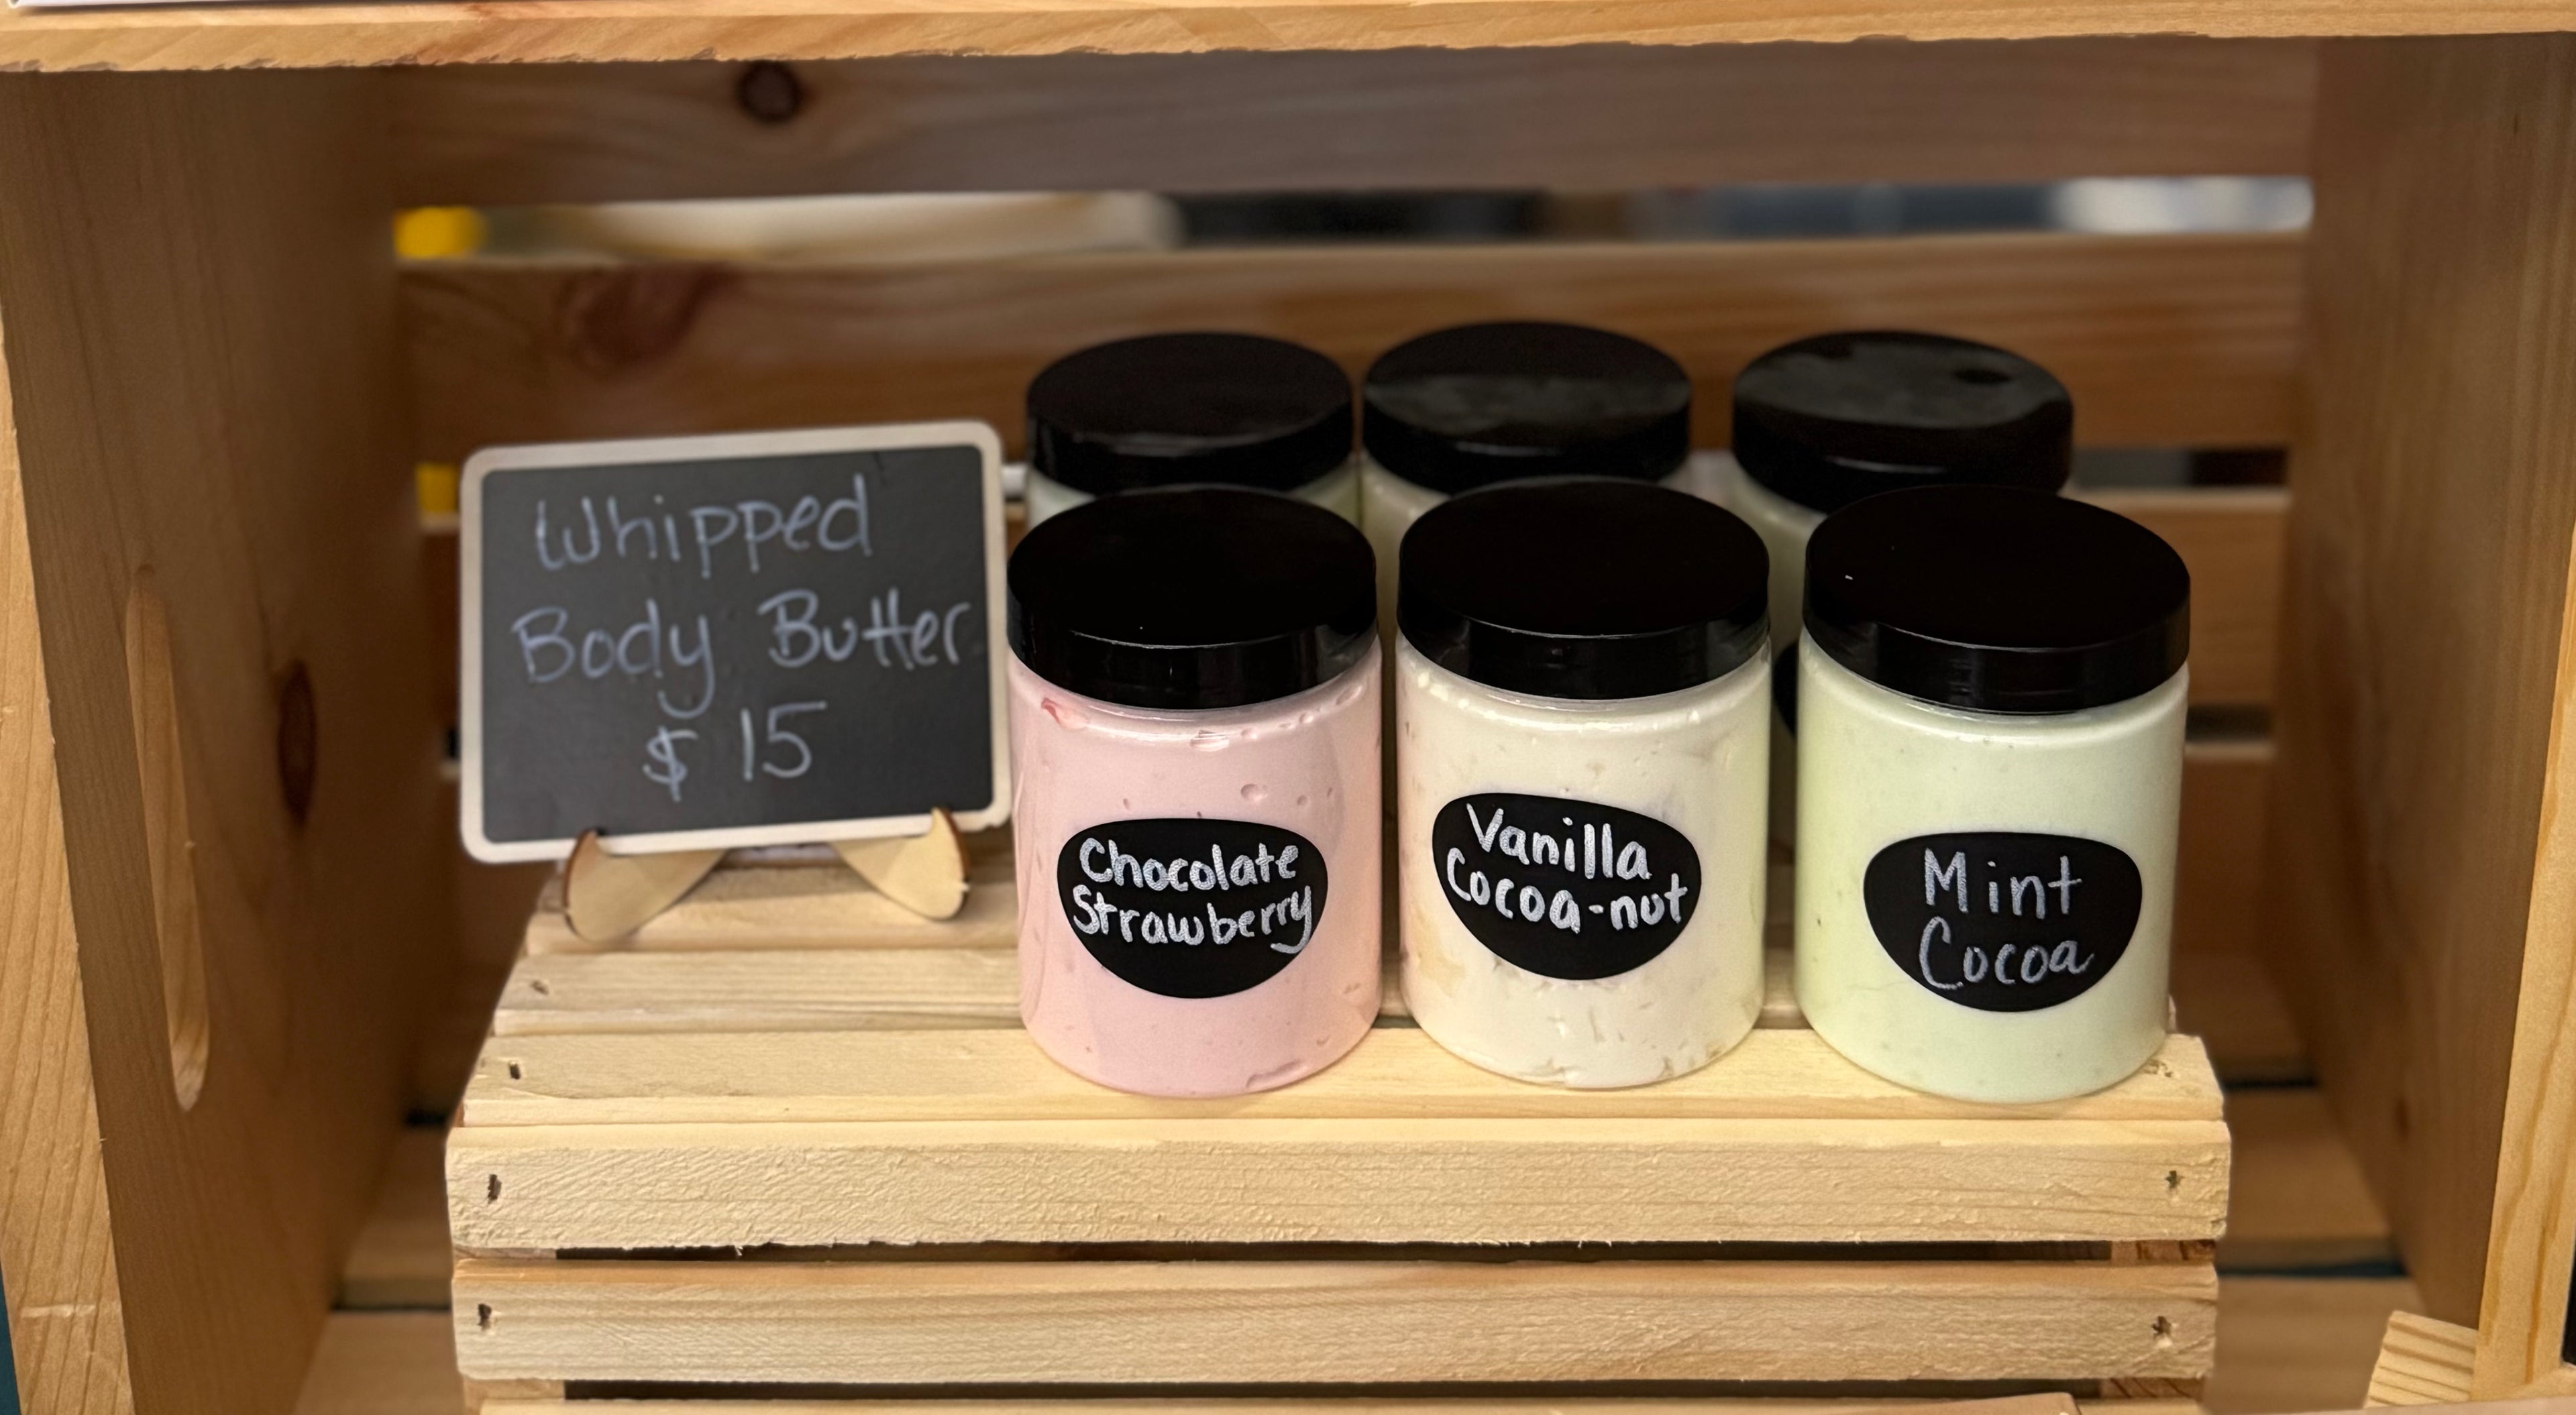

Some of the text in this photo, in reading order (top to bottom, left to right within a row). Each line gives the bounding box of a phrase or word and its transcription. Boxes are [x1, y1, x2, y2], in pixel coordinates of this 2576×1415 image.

[536, 473, 872, 579] Whipped
[512, 587, 971, 719] Body Butter
[1079, 838, 1299, 891] Chocolate
[1466, 803, 1652, 880] Vanilla
[1073, 884, 1311, 954] Strawberry
[1447, 847, 1688, 934] Cocoa-nut
[1925, 847, 2082, 919] Mint
[1919, 916, 2095, 990] Cocoa
